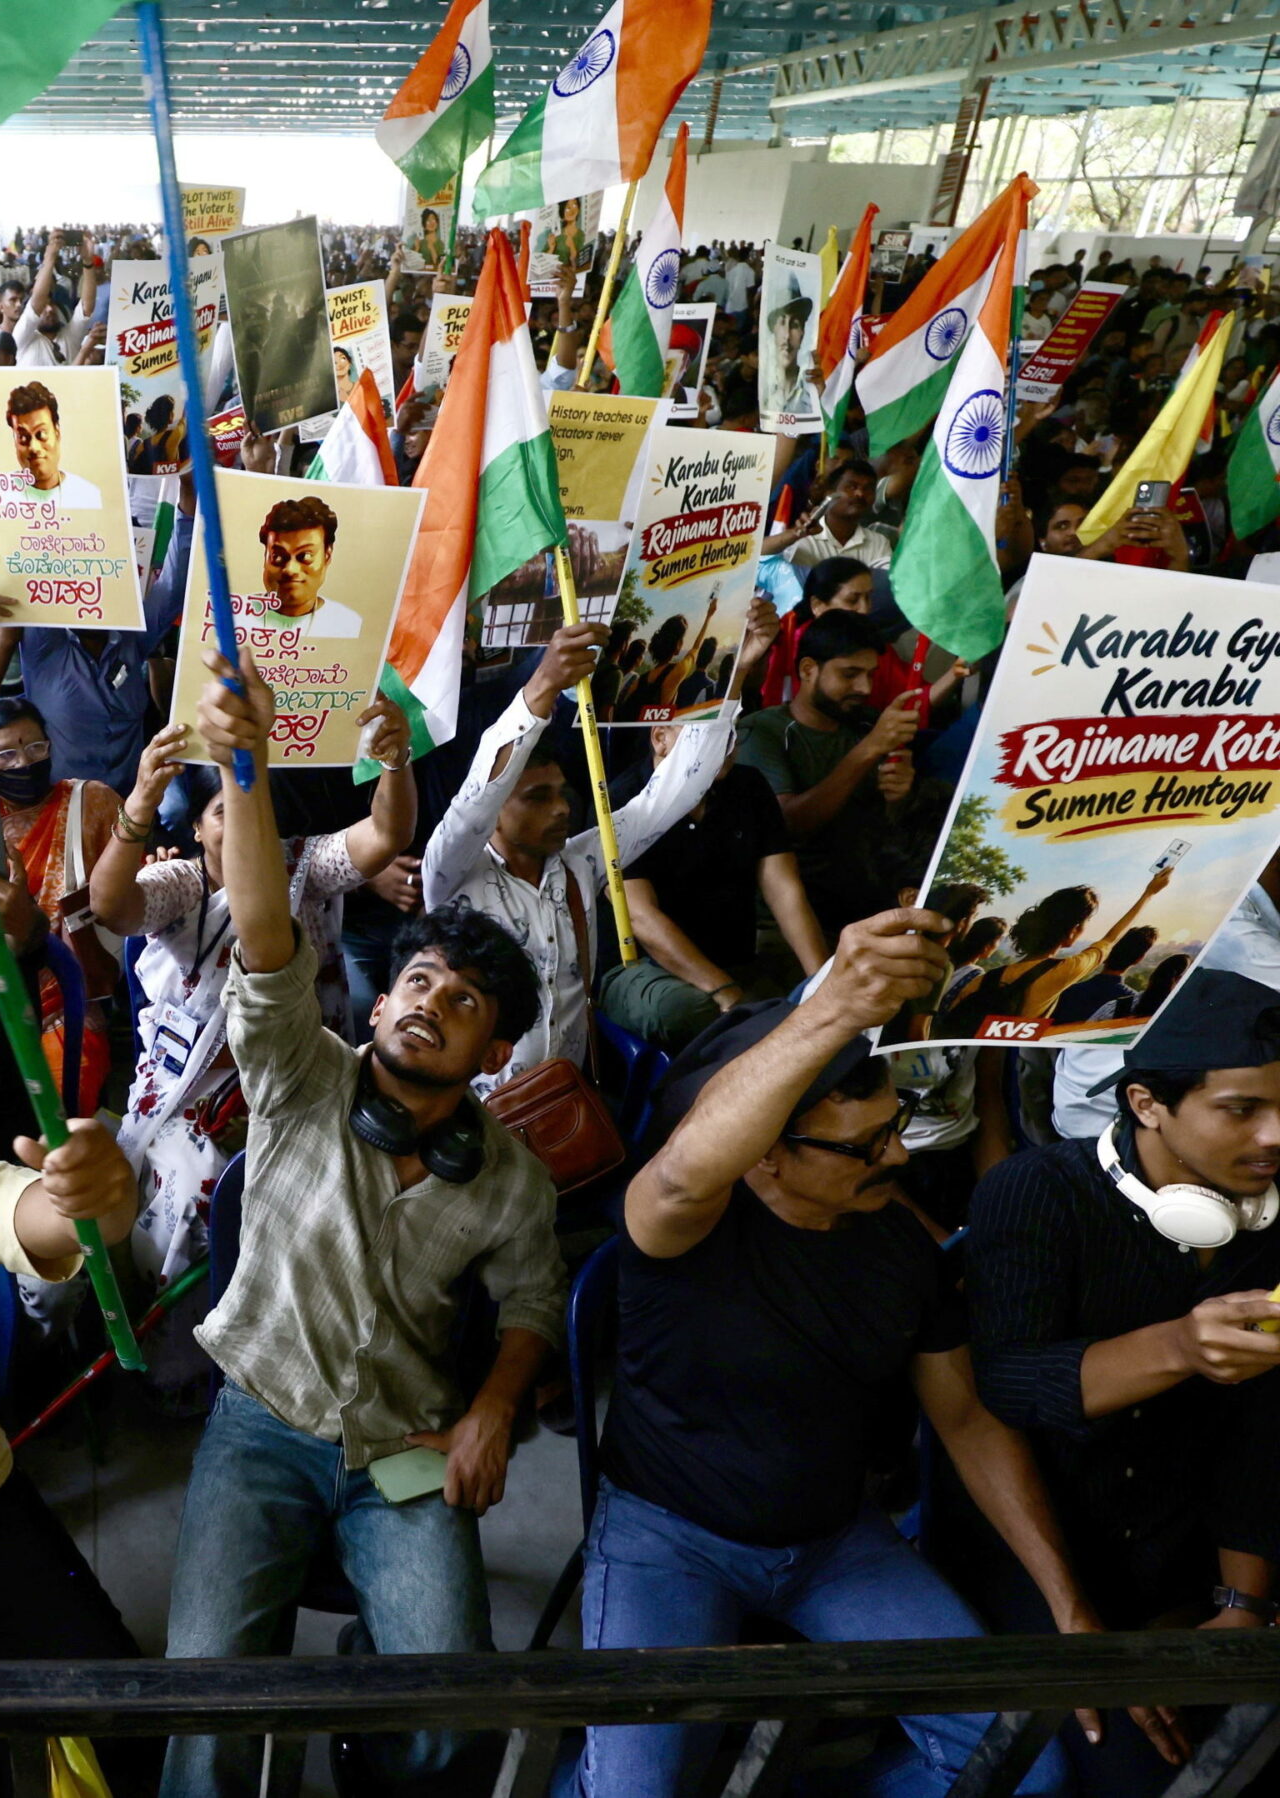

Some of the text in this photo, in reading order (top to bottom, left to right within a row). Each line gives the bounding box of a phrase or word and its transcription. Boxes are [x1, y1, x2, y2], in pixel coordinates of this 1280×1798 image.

[200, 203, 225, 215] Voter
[131, 281, 173, 304] Kara
[333, 288, 367, 307] TWIST:
[362, 301, 371, 312] Is
[447, 308, 471, 320] PLO
[339, 314, 376, 335] Alive.
[131, 349, 173, 374] Sumne
[551, 404, 648, 425] History teaches us
[776, 414, 797, 425] DSO
[595, 431, 624, 441] never
[156, 463, 178, 474] KVS
[664, 450, 758, 488] Karabu Gyanu
[680, 477, 736, 514] Karabu
[647, 505, 756, 555] Rajiname Kottu
[648, 541, 747, 585] Sumne Hontogu
[26, 577, 103, 619] ಬಿಡಲ್ಲ
[1060, 611, 1220, 669] Karabu
[1100, 663, 1262, 718] Karabu
[643, 707, 671, 721] KVS
[1012, 719, 1280, 784] Rajiname Kott
[1016, 775, 1273, 830] Sumne Hontogu
[985, 1020, 1040, 1039] KVS
